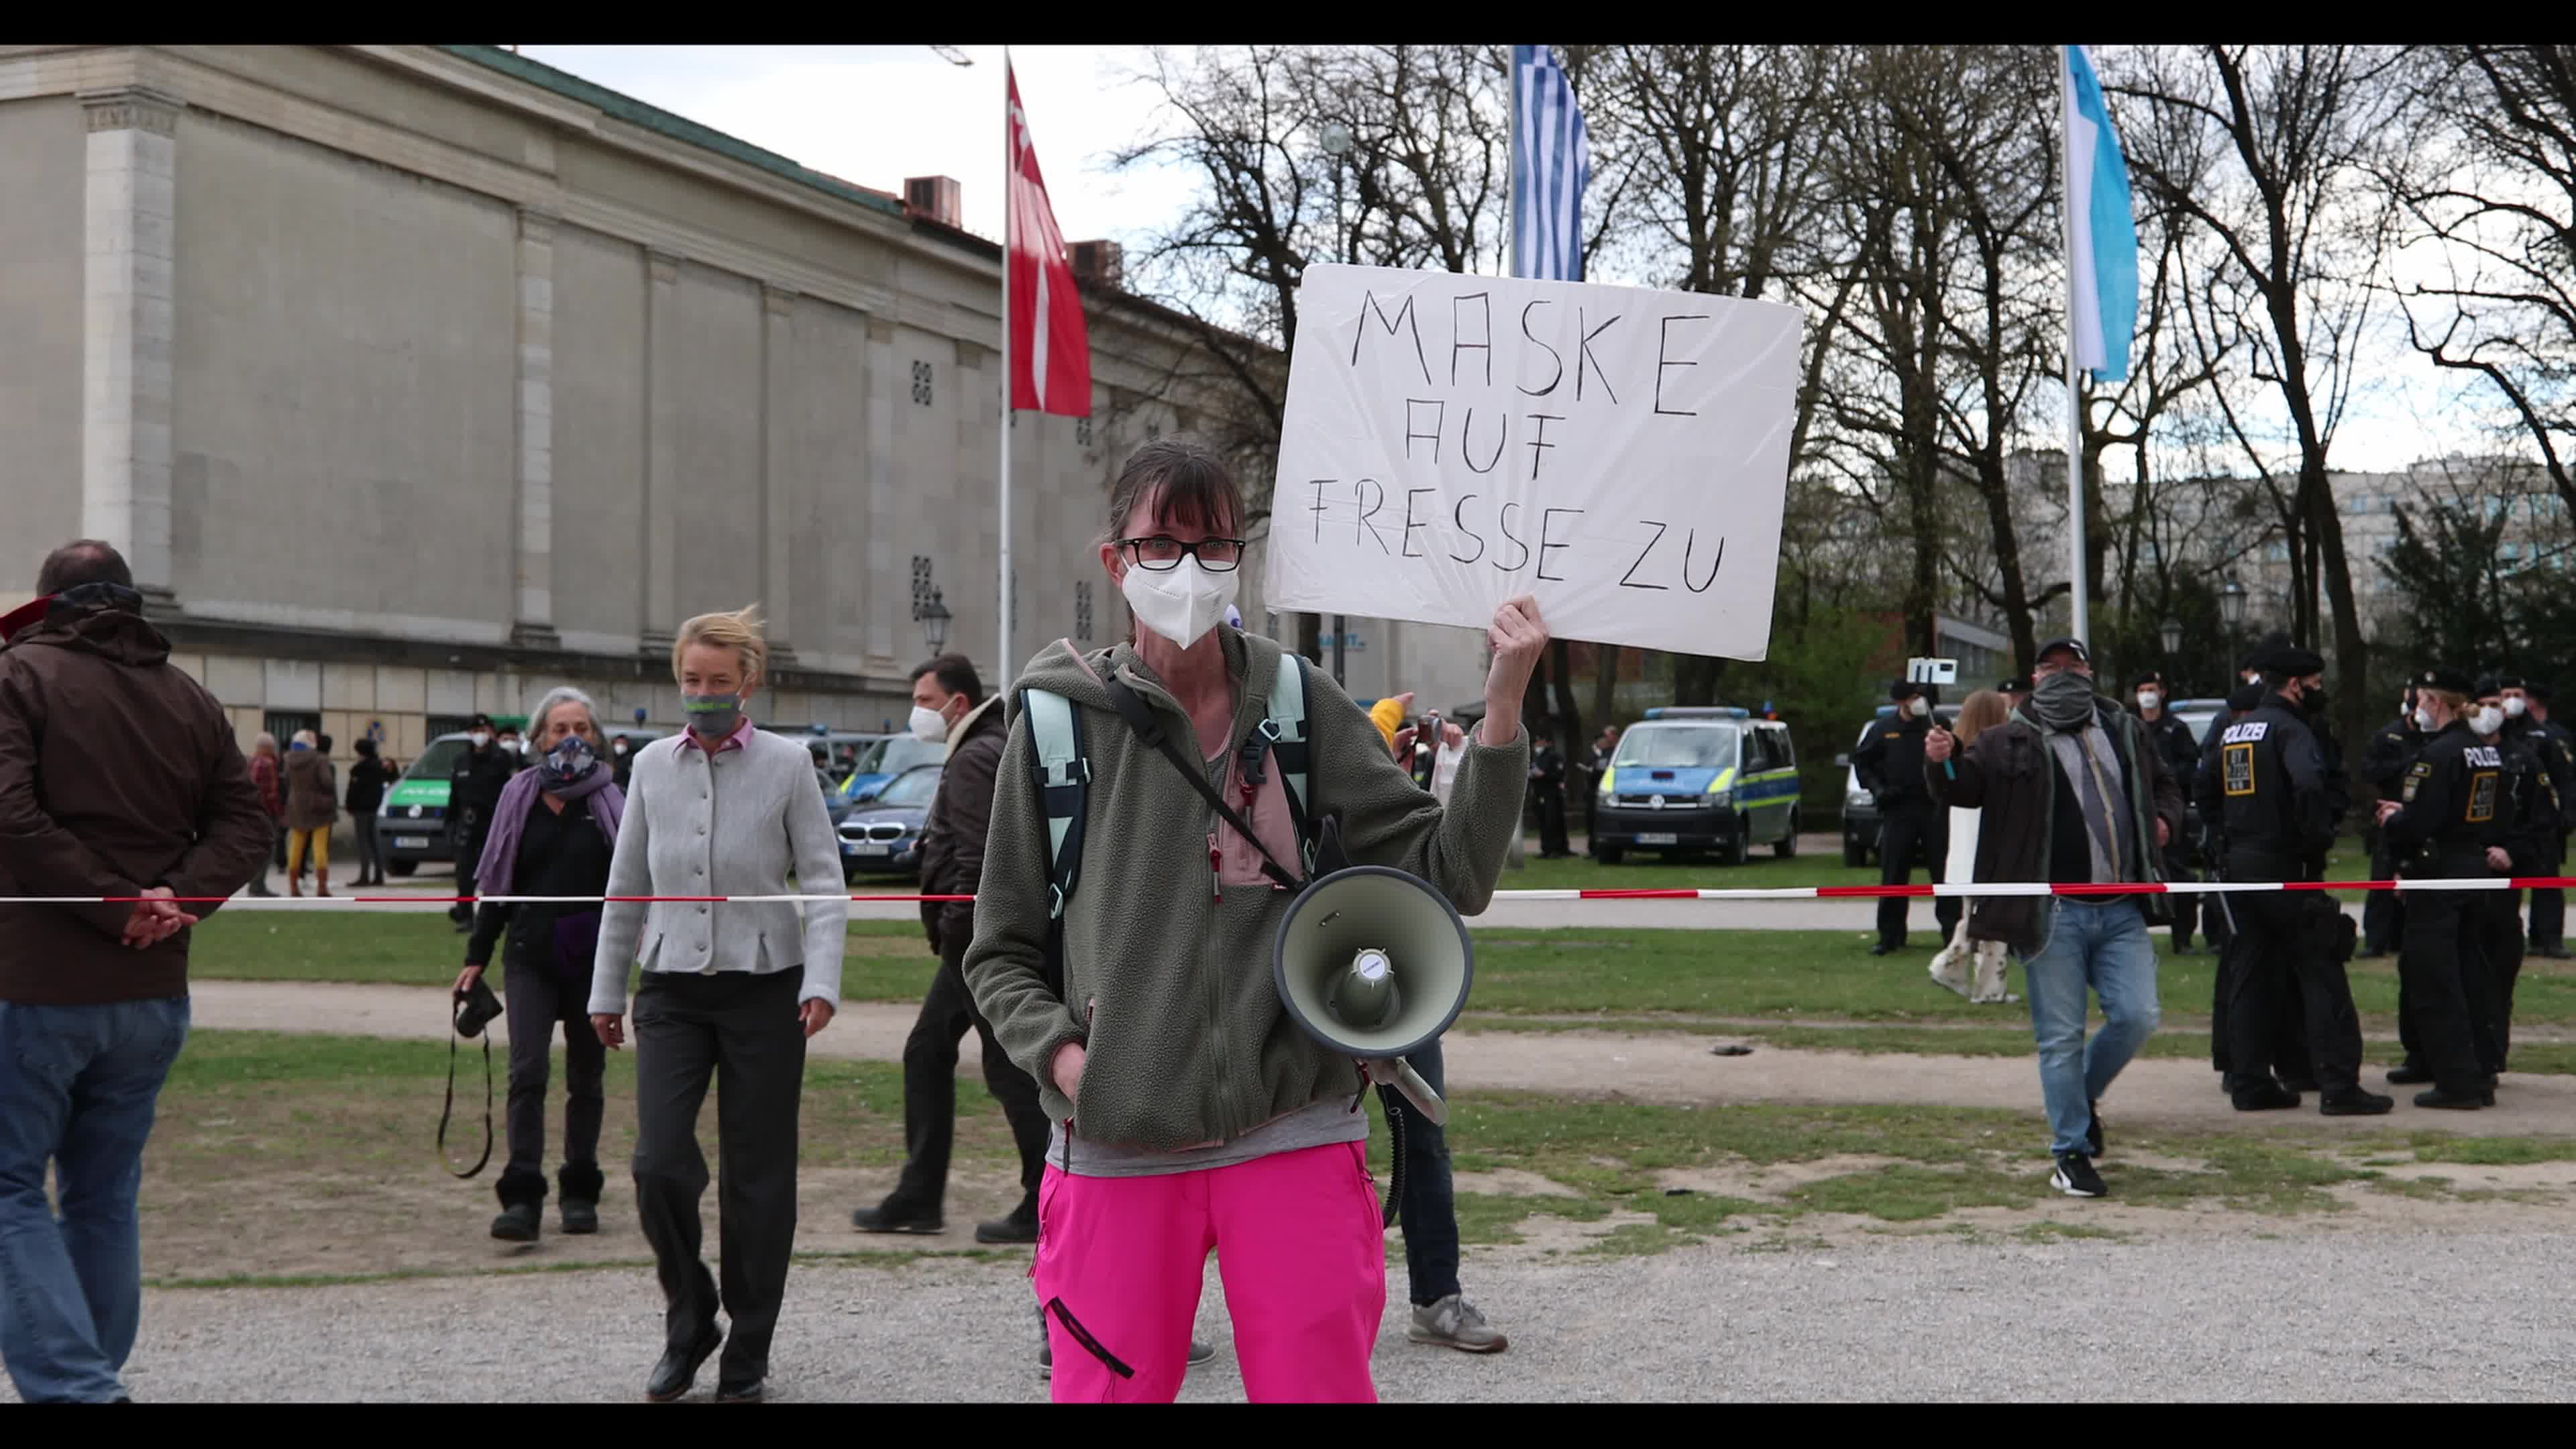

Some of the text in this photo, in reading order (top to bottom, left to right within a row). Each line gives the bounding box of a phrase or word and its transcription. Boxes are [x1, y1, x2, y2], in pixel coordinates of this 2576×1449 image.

[1351, 289, 1711, 417] MASKE
[1405, 398, 1566, 481] AUF
[1309, 478, 1725, 594] FRESSE ZU
